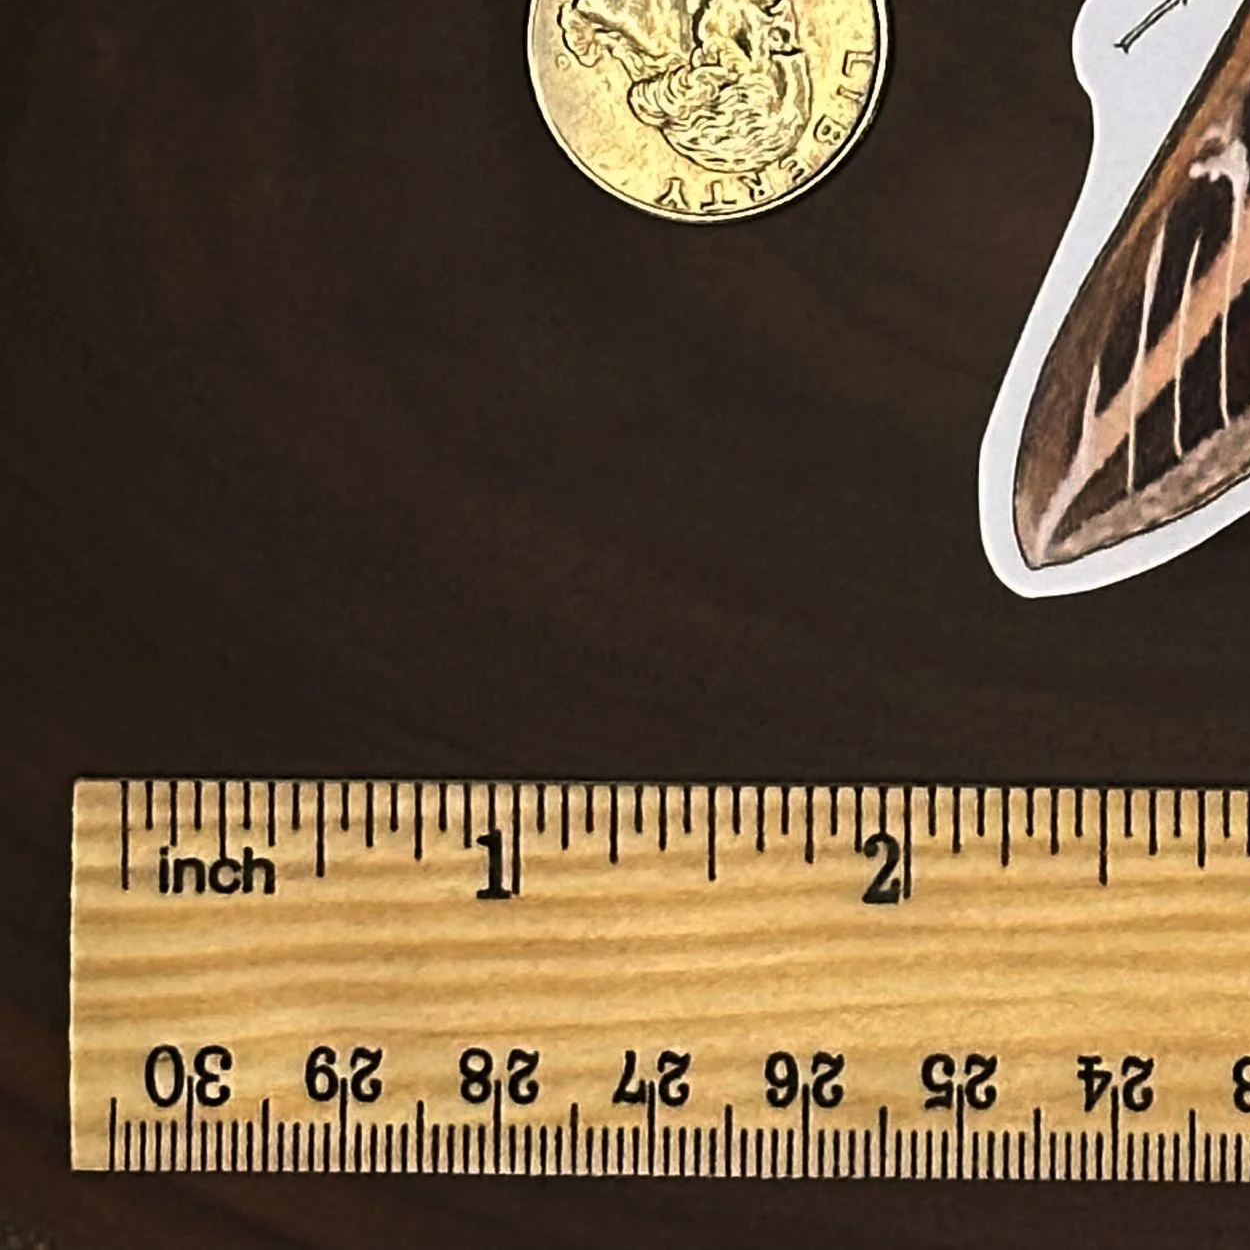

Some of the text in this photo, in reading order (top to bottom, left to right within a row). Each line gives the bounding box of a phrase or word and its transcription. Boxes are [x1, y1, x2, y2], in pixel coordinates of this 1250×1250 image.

[658, 49, 875, 211] LIBERTY
[158, 846, 276, 895] inch
[476, 830, 513, 900] 1
[862, 833, 902, 905] 2
[145, 1045, 233, 1108] 30
[304, 1045, 385, 1105] 29
[458, 1048, 541, 1105] 28
[612, 1050, 692, 1108] 27
[764, 1050, 846, 1109] 26
[921, 1053, 998, 1112] 25
[1077, 1053, 1155, 1114] 24
